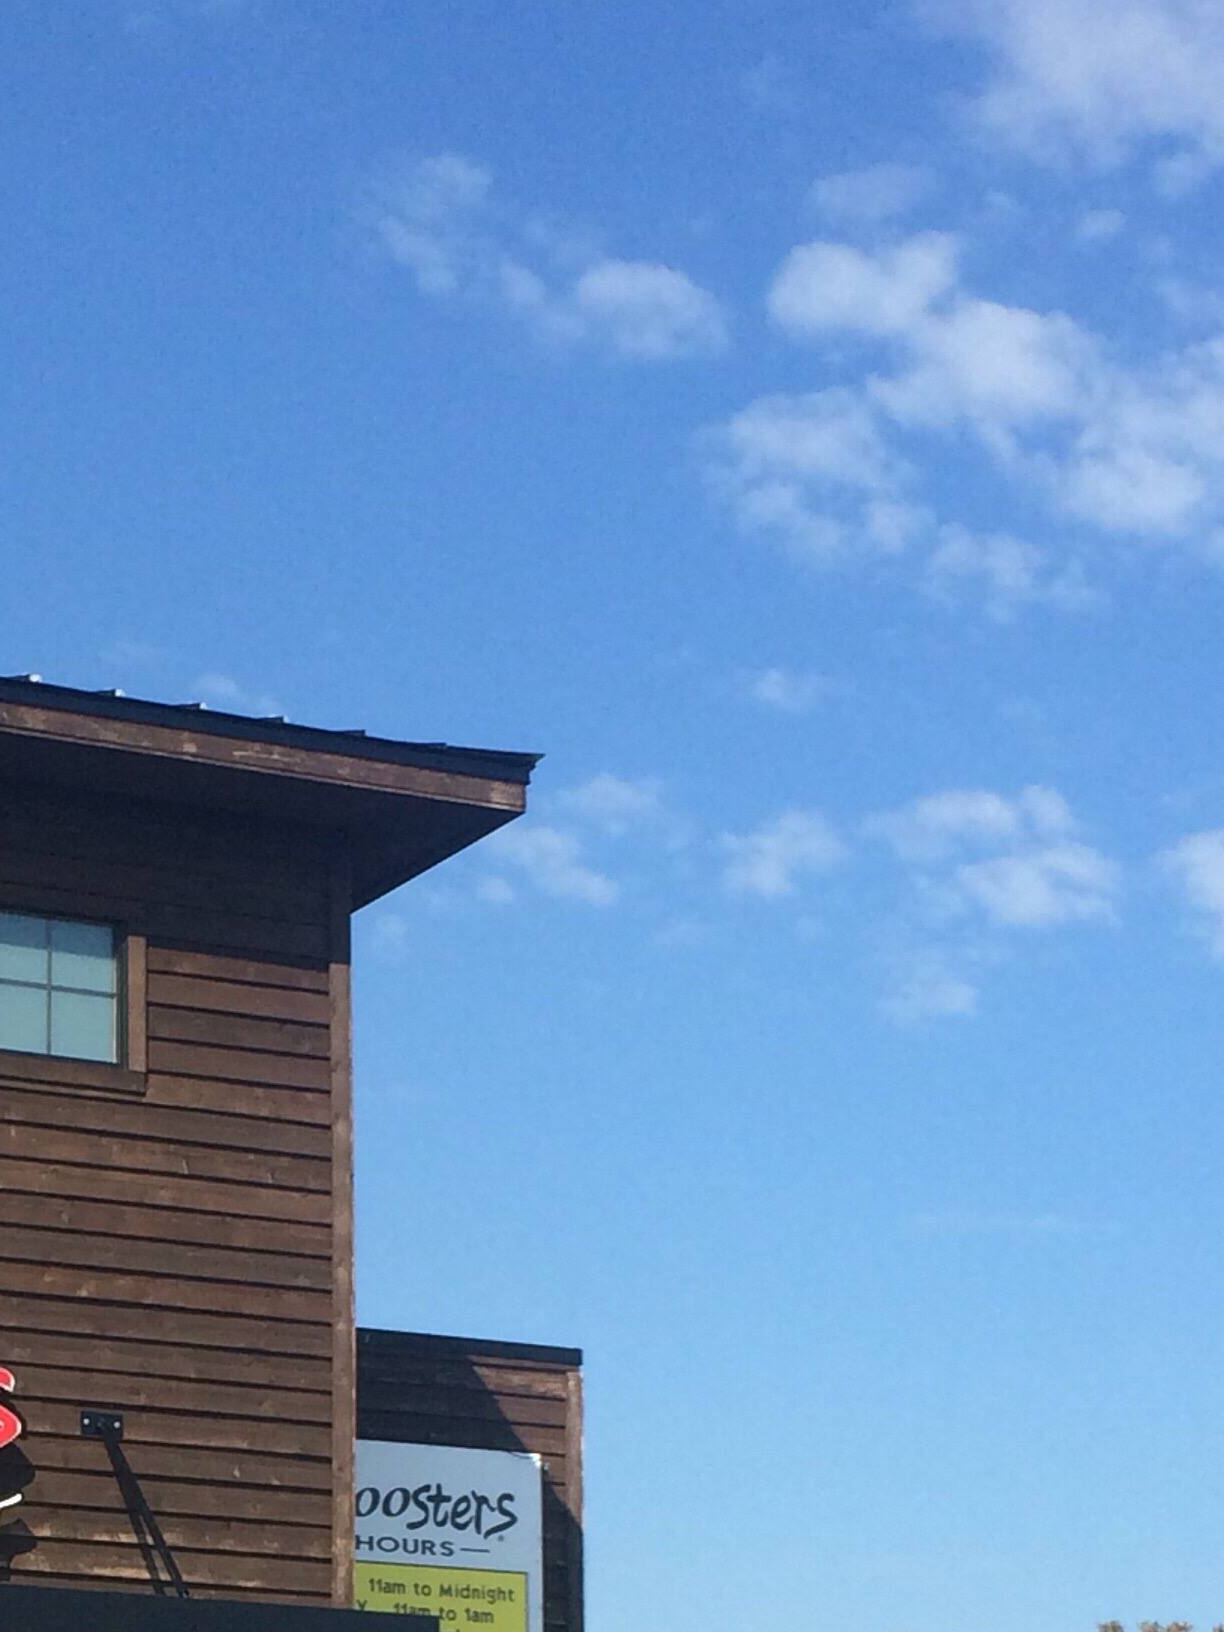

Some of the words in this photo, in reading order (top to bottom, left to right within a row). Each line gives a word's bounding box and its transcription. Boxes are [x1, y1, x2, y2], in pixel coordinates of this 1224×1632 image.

[369, 1578, 406, 1595] 11am
[414, 1584, 432, 1597] to
[439, 1584, 515, 1604] Midnight
[439, 1607, 456, 1621] to
[464, 1607, 494, 1623] 1am
